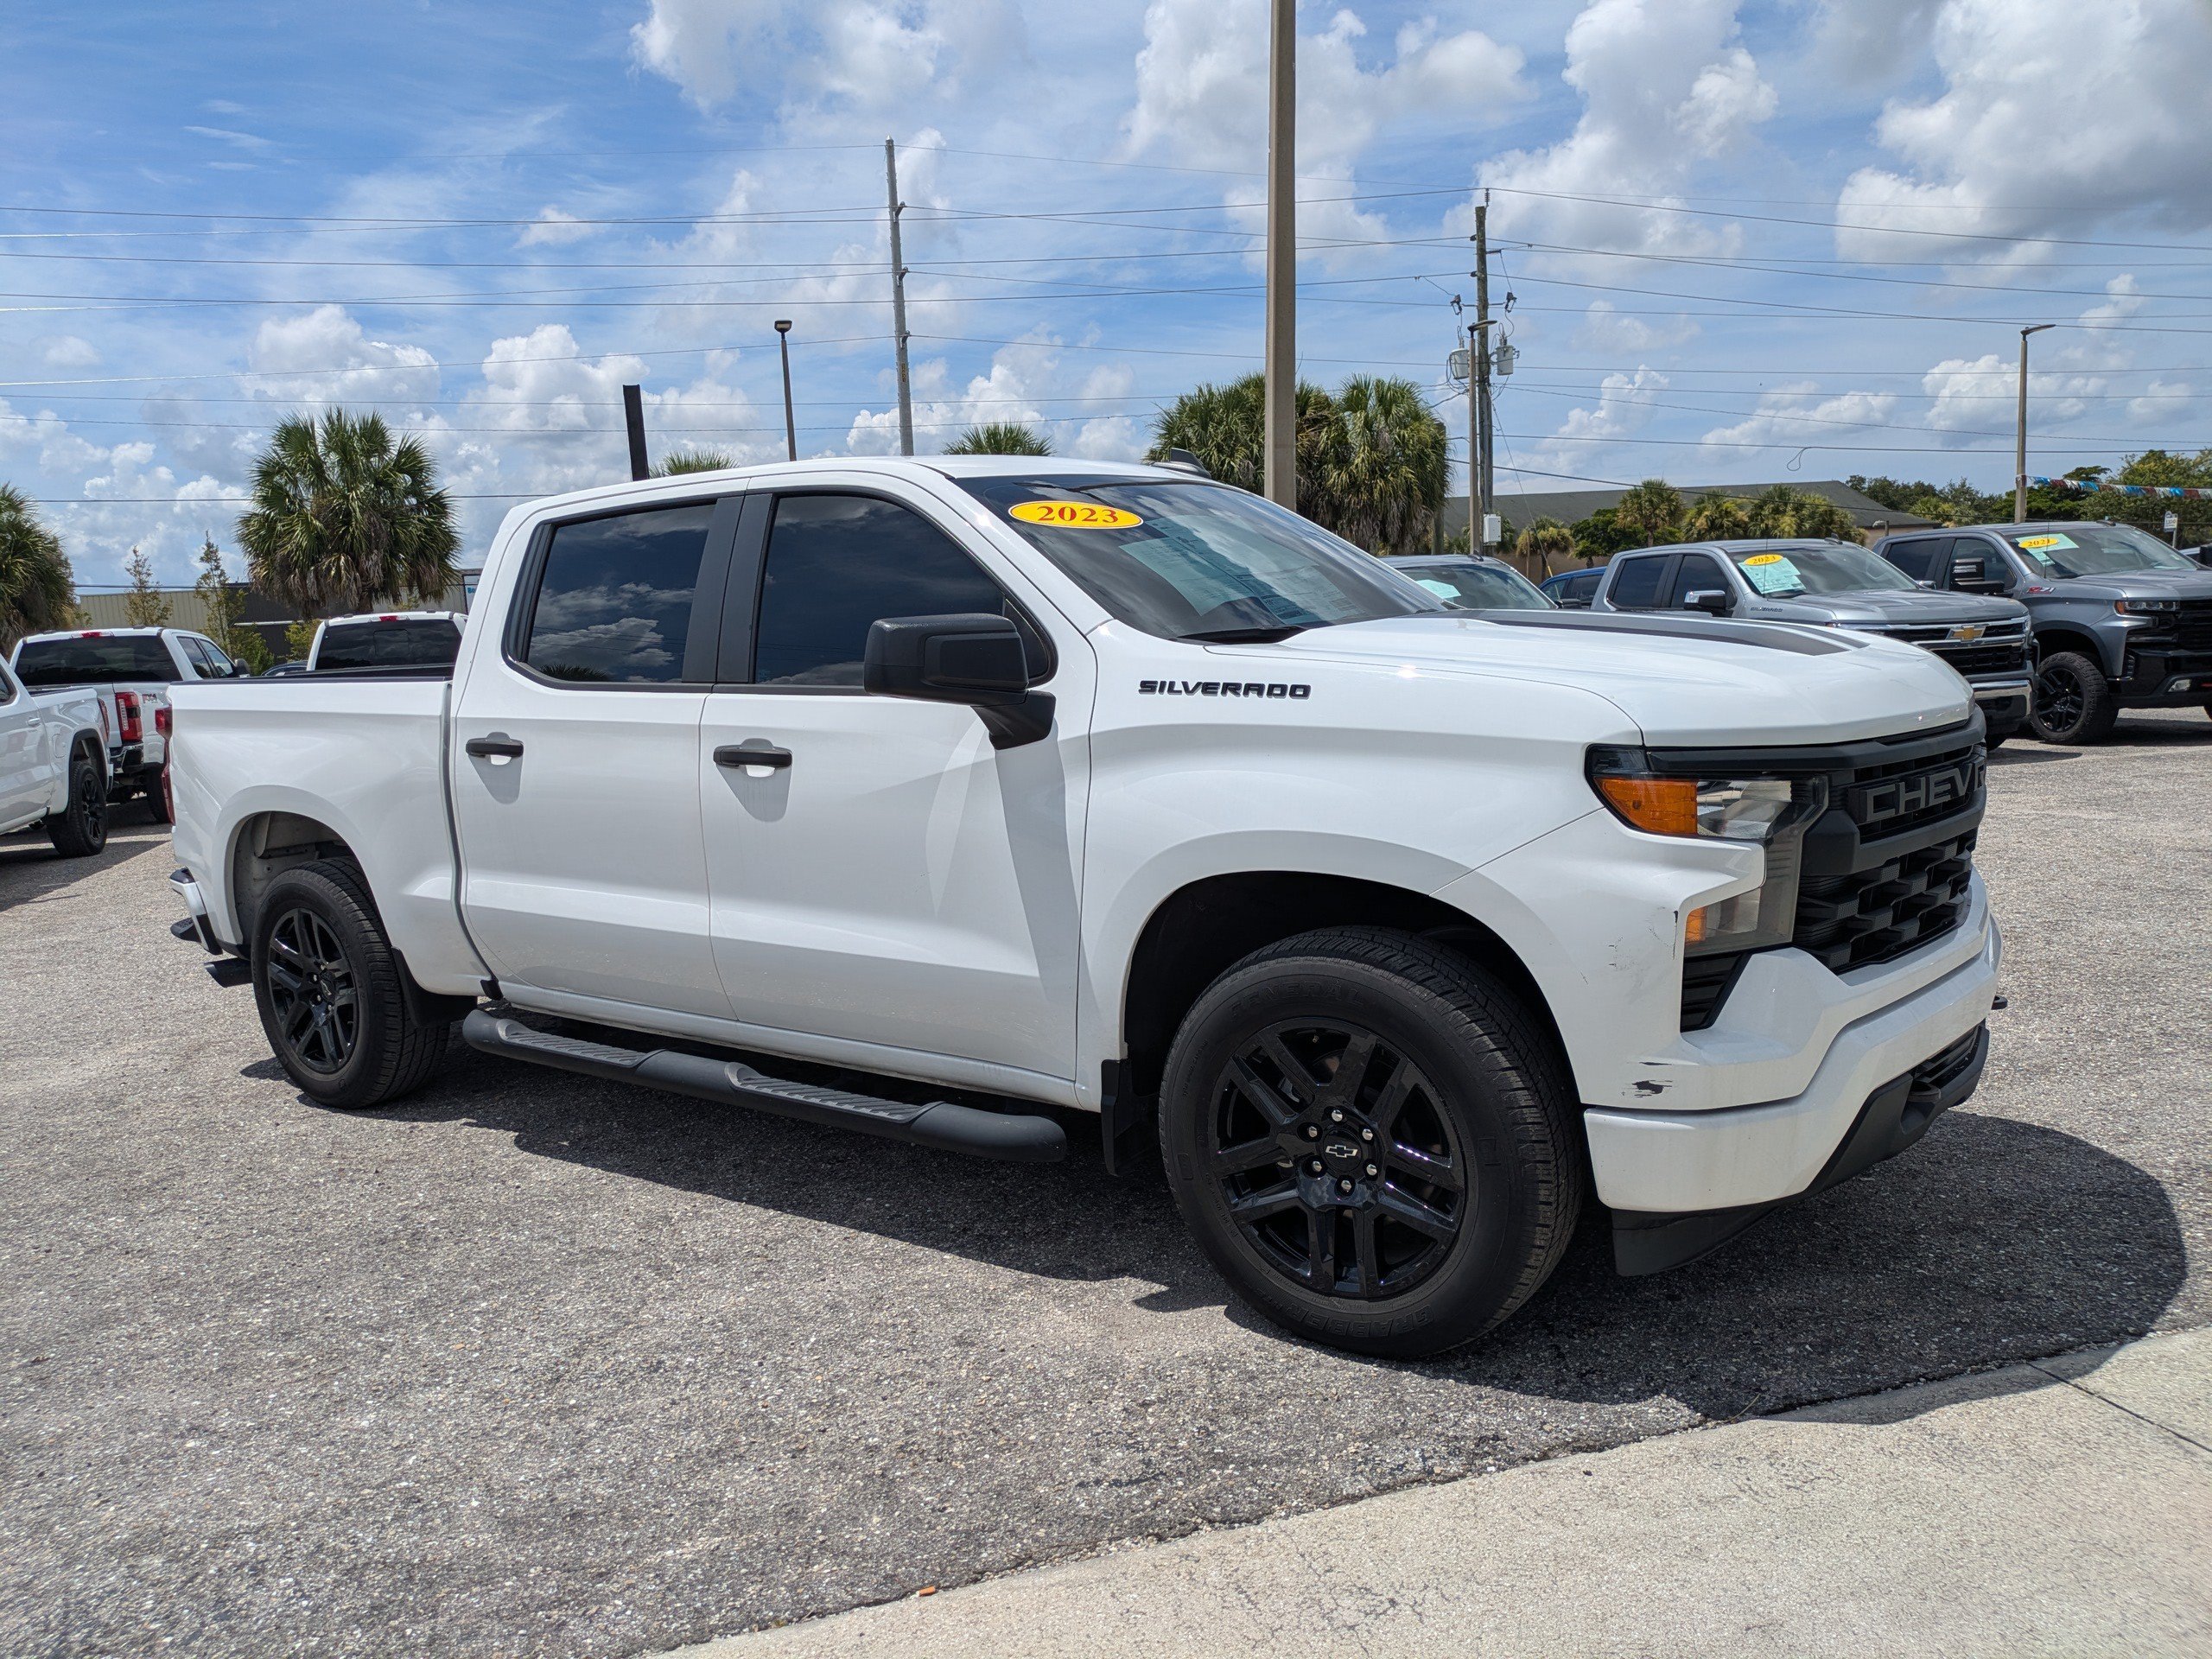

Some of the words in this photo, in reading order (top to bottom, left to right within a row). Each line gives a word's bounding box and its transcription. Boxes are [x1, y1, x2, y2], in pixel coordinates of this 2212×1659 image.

[1037, 505, 1118, 523] 2023
[2028, 538, 2050, 547] 2021
[1753, 556, 1777, 564] 2023
[1139, 680, 1312, 700] SILVERADO
